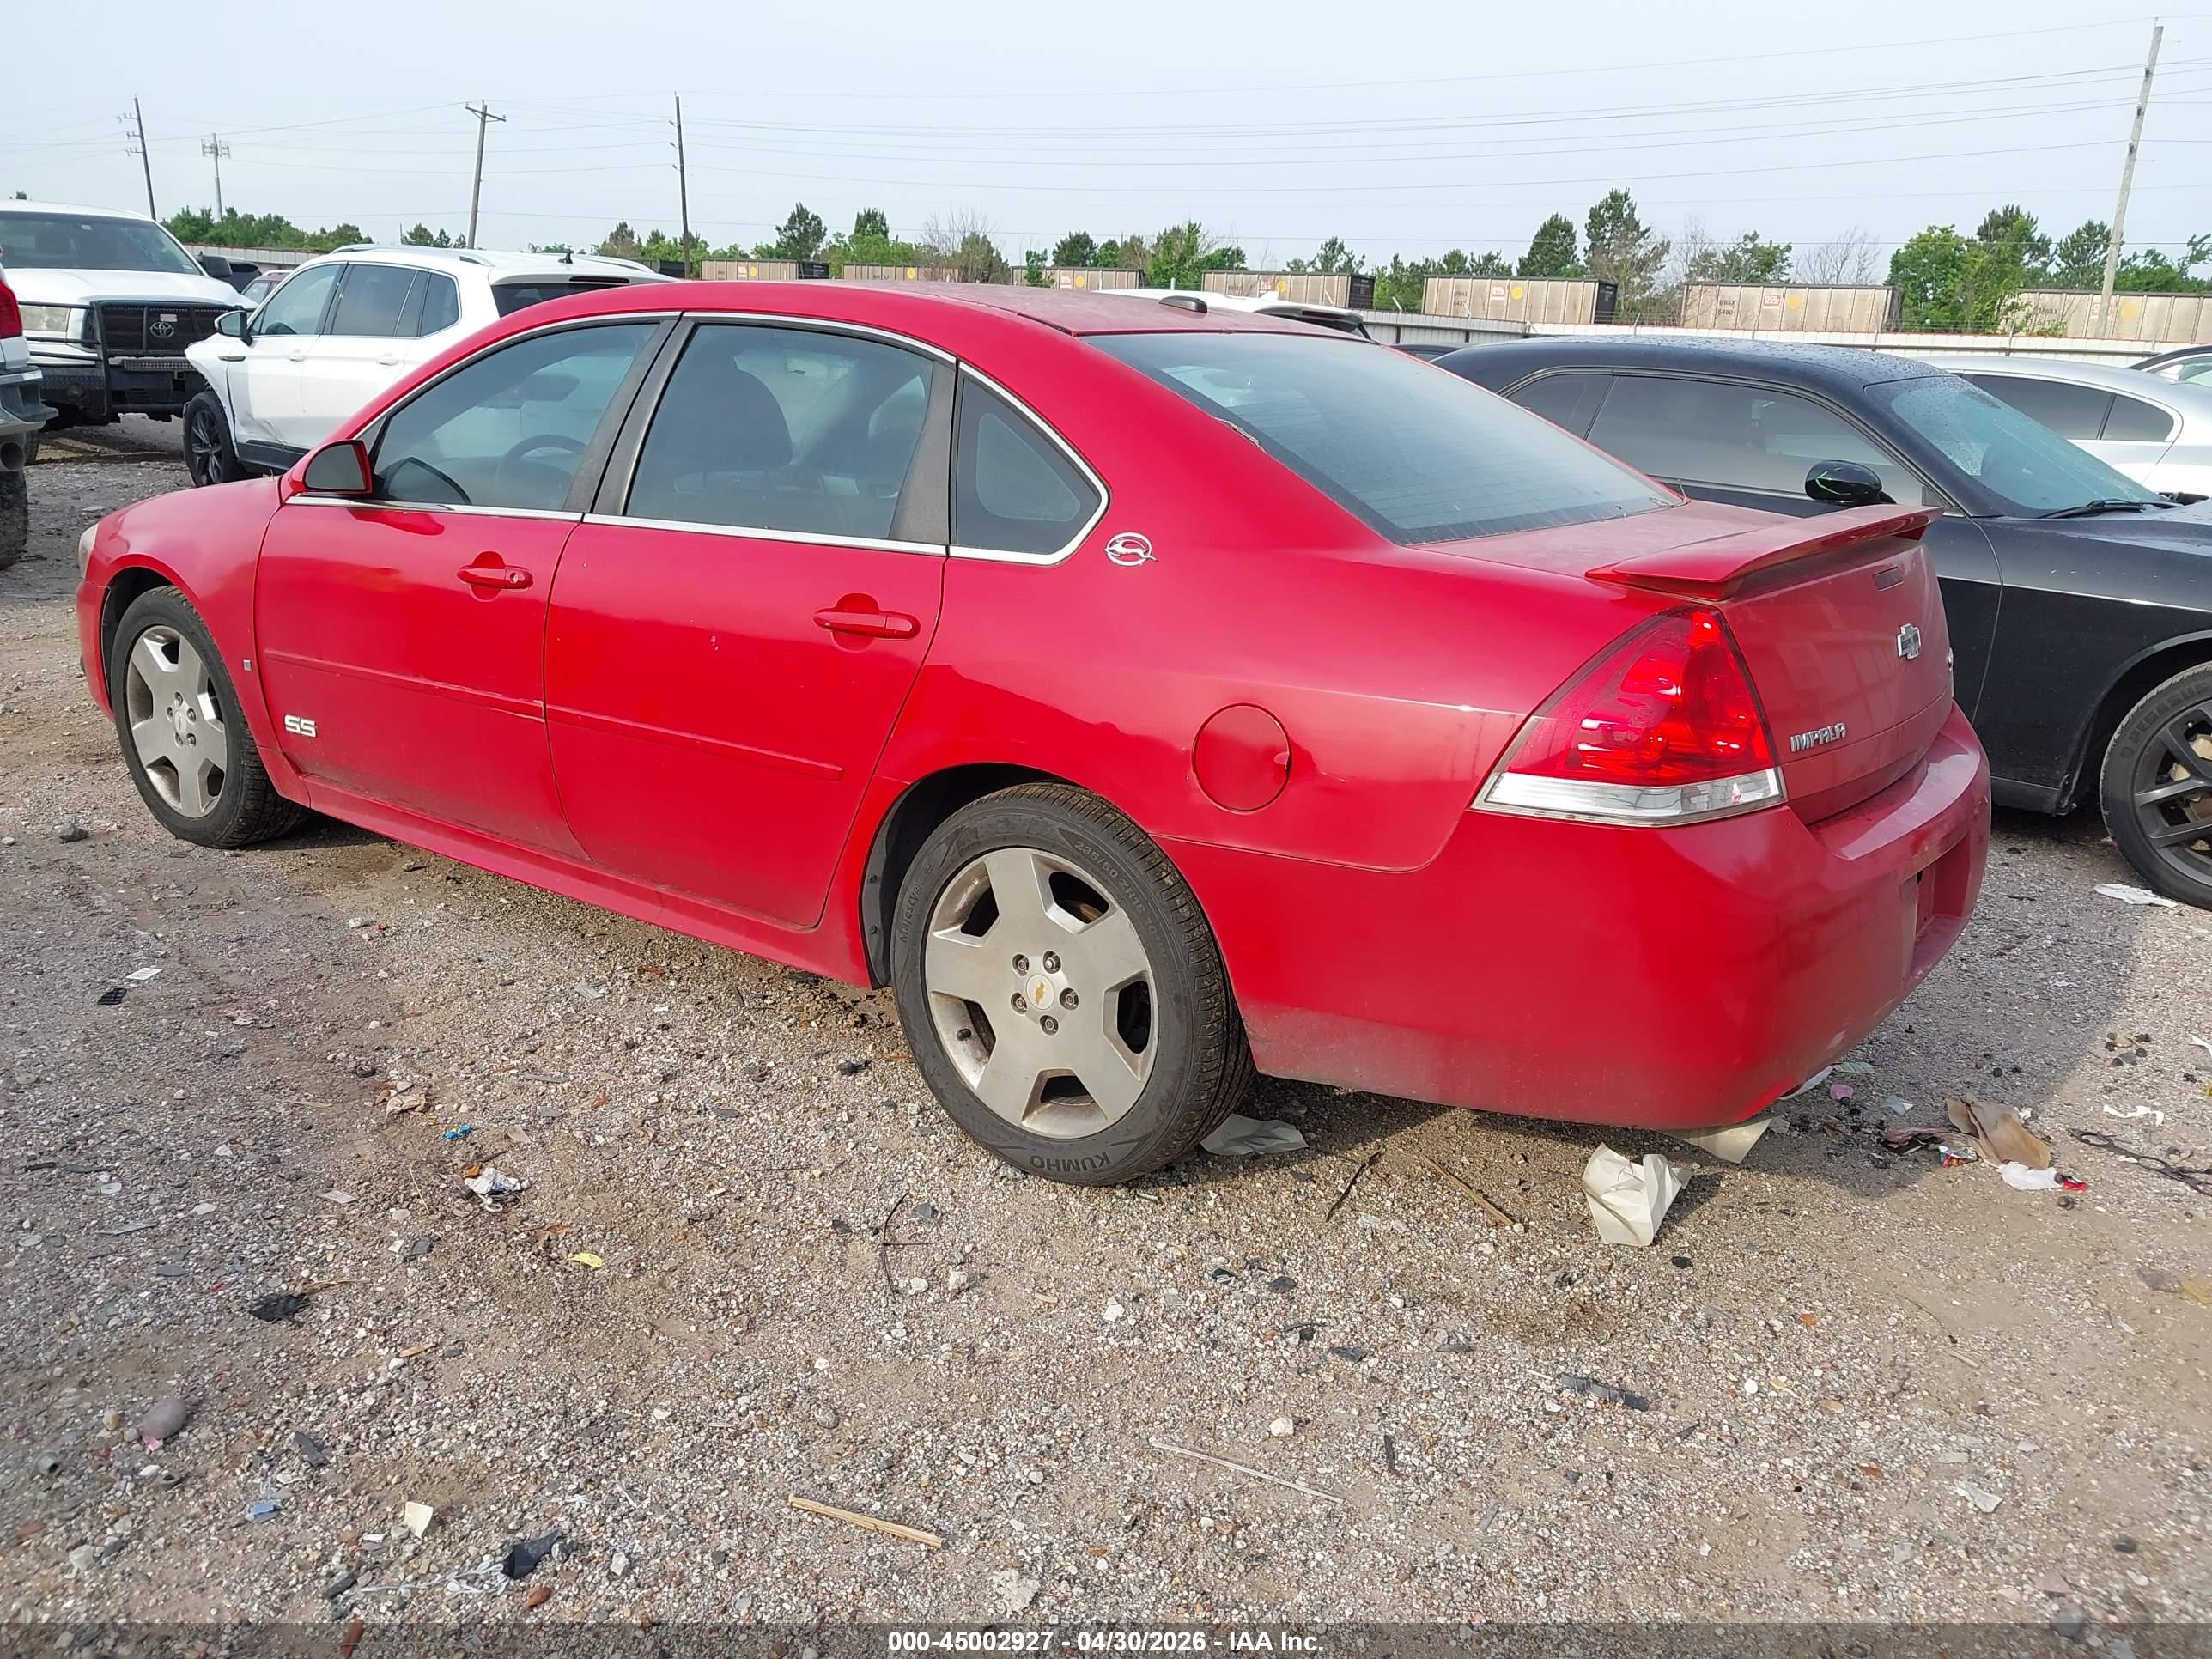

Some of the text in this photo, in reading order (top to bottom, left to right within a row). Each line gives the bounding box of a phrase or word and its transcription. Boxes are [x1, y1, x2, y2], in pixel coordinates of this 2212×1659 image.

[284, 714, 318, 738] SS
[1790, 722, 1846, 752] IMPALA
[1074, 840, 1118, 878] 235/50
[1029, 1152, 1111, 1172] KUMHO
